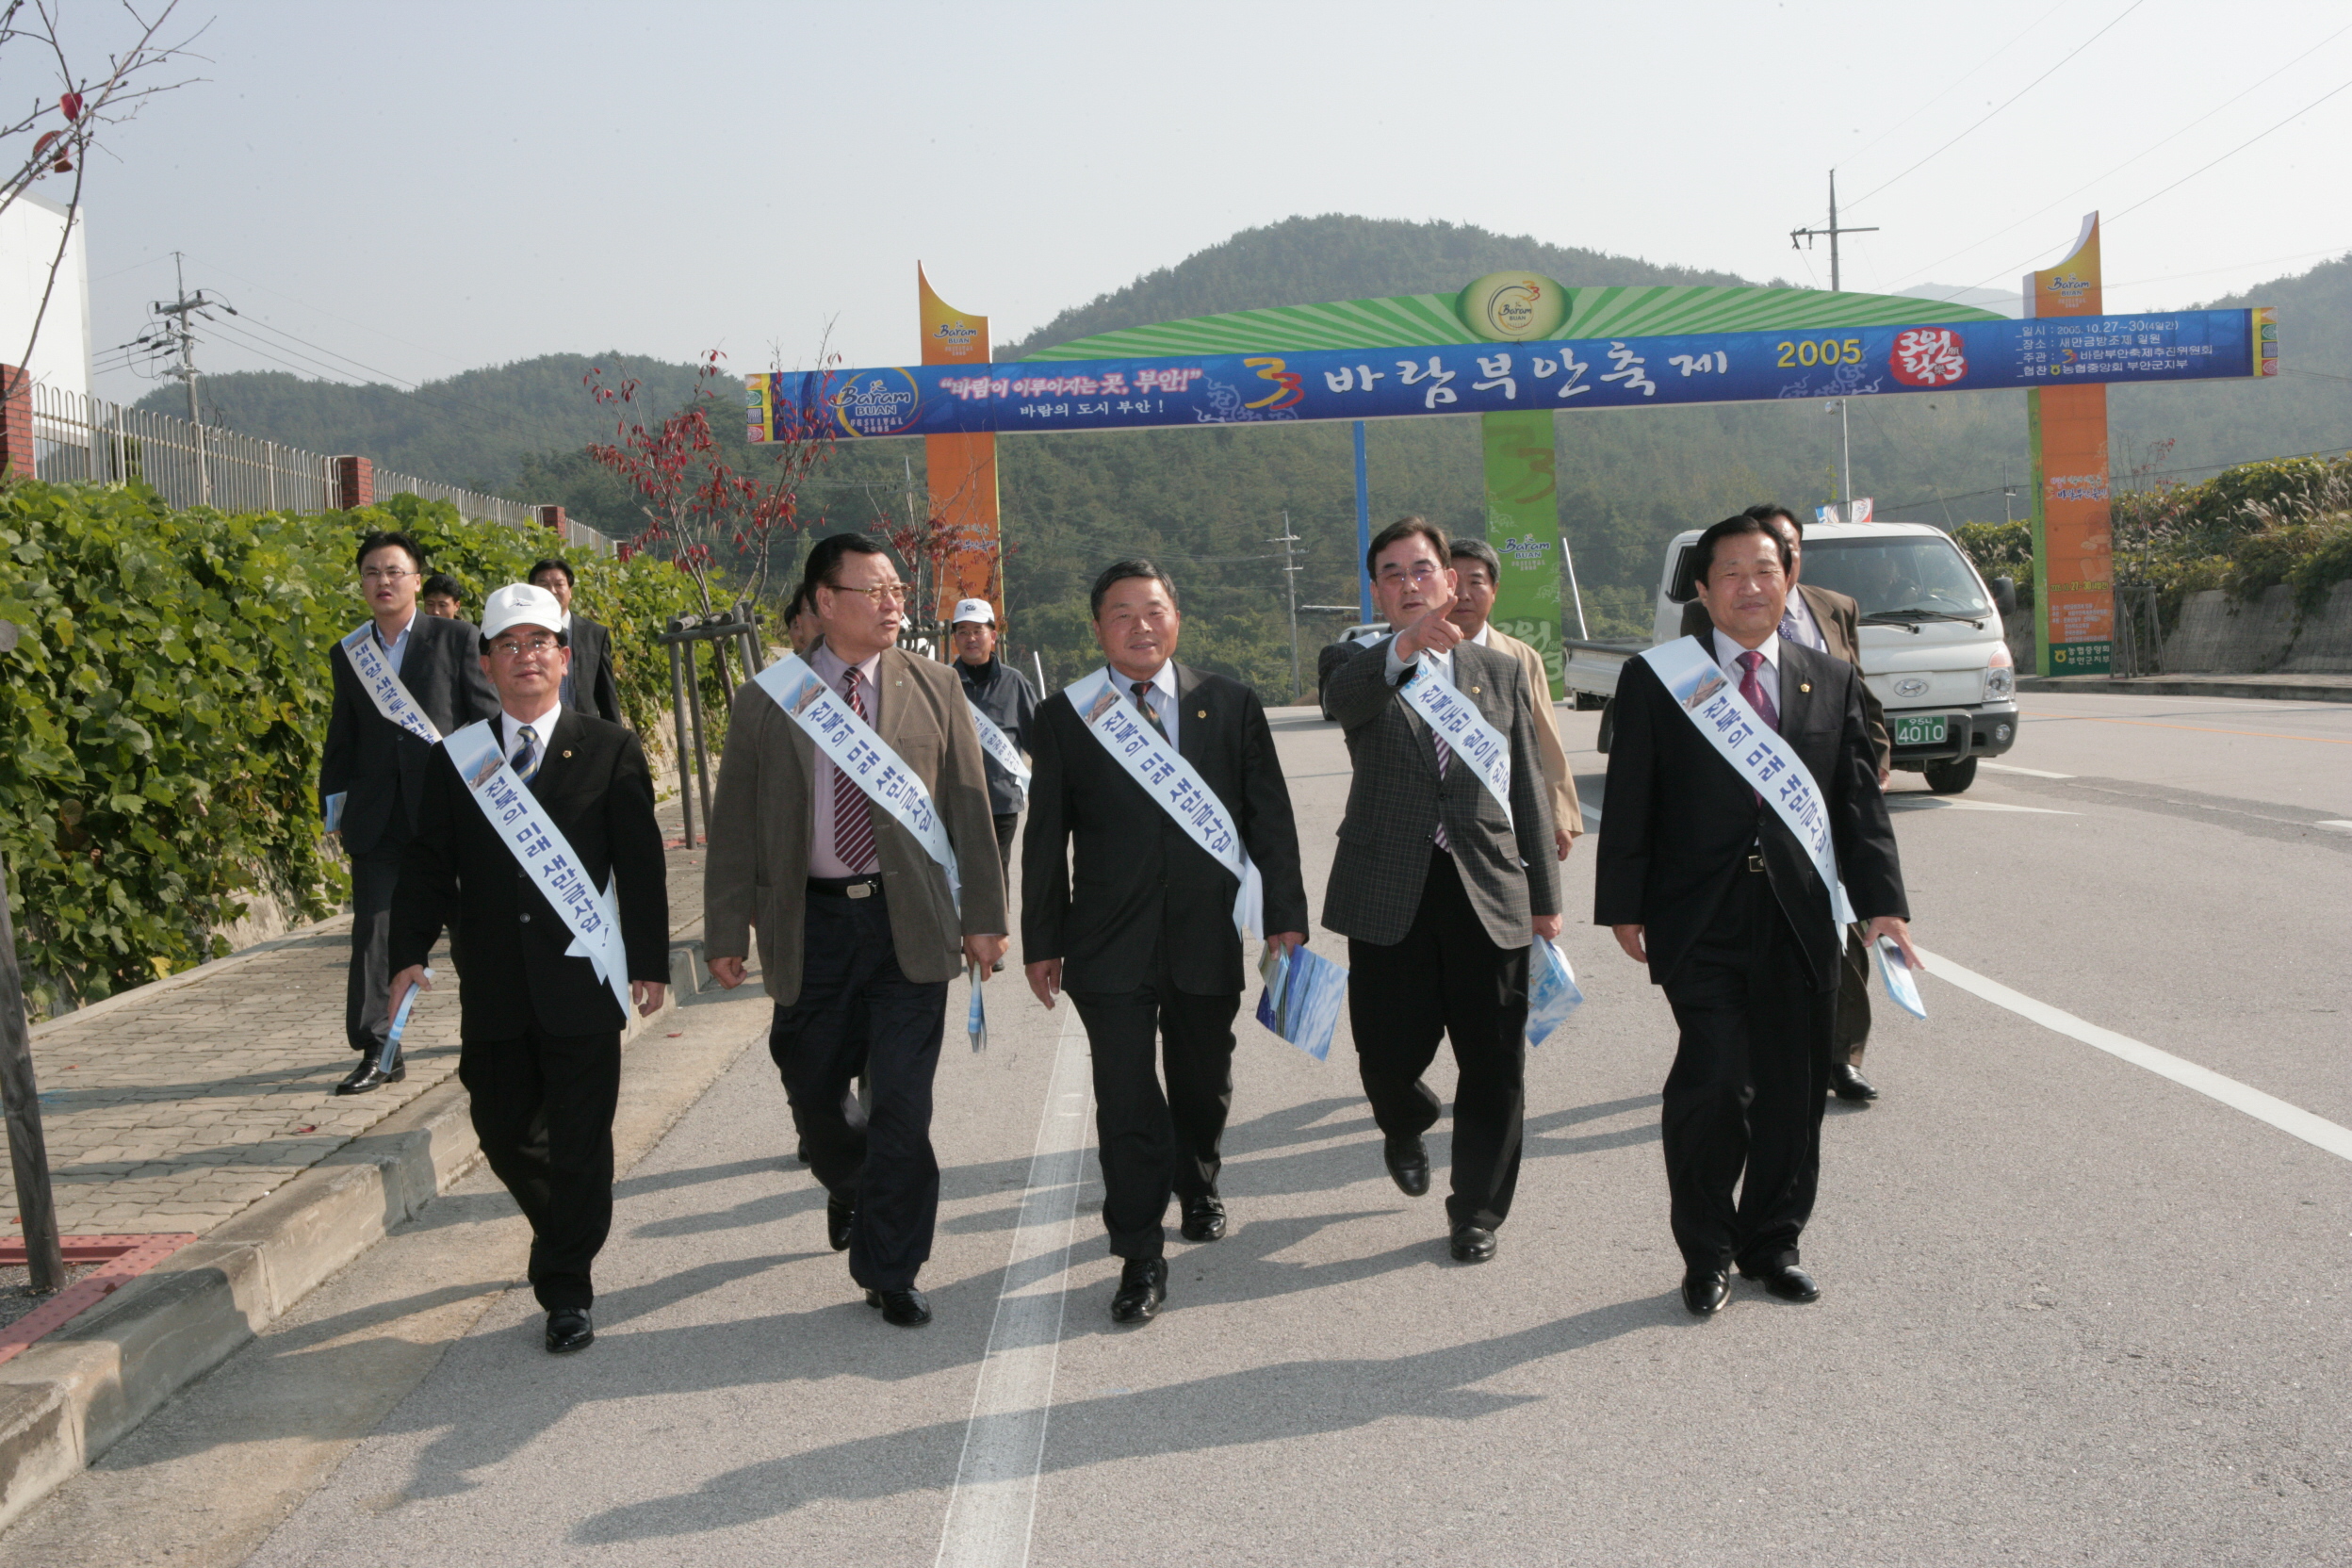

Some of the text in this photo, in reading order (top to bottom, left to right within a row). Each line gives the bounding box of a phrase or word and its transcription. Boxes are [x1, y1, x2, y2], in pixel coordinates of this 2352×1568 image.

[2047, 277, 2090, 291] Baram
[1498, 303, 1533, 316] Baram
[933, 324, 977, 338] Baram
[2059, 335, 2132, 348] 새만금방조제
[2137, 333, 2161, 345] 일원
[1777, 338, 1862, 368] 2005
[2080, 345, 2213, 361] 바람부안축제추진위원회
[2063, 362, 2123, 375] 농협중앙회
[2127, 359, 2189, 371] 부안군지부
[1012, 375, 1099, 399] 이루어지는
[828, 386, 911, 408] Baram
[856, 405, 897, 416] BUAN
[1020, 402, 1070, 417] 바람의
[1076, 401, 1110, 416] 도시
[850, 417, 904, 428] FESTIVAL
[1497, 538, 1551, 553] Baram
[2068, 645, 2110, 656] 농협중앙회
[2068, 655, 2110, 665] 부안군지부
[1418, 684, 1472, 734] 전북도민
[808, 700, 855, 747] 전북의
[846, 740, 881, 775] 미래
[1703, 694, 1755, 749] 전북의
[1745, 742, 1787, 782] 미래
[1899, 725, 1944, 743] 4010
[1102, 710, 1150, 757] 전북의
[1139, 752, 1176, 786] 미래
[484, 776, 528, 825] 전북의
[515, 822, 552, 858] 미래
